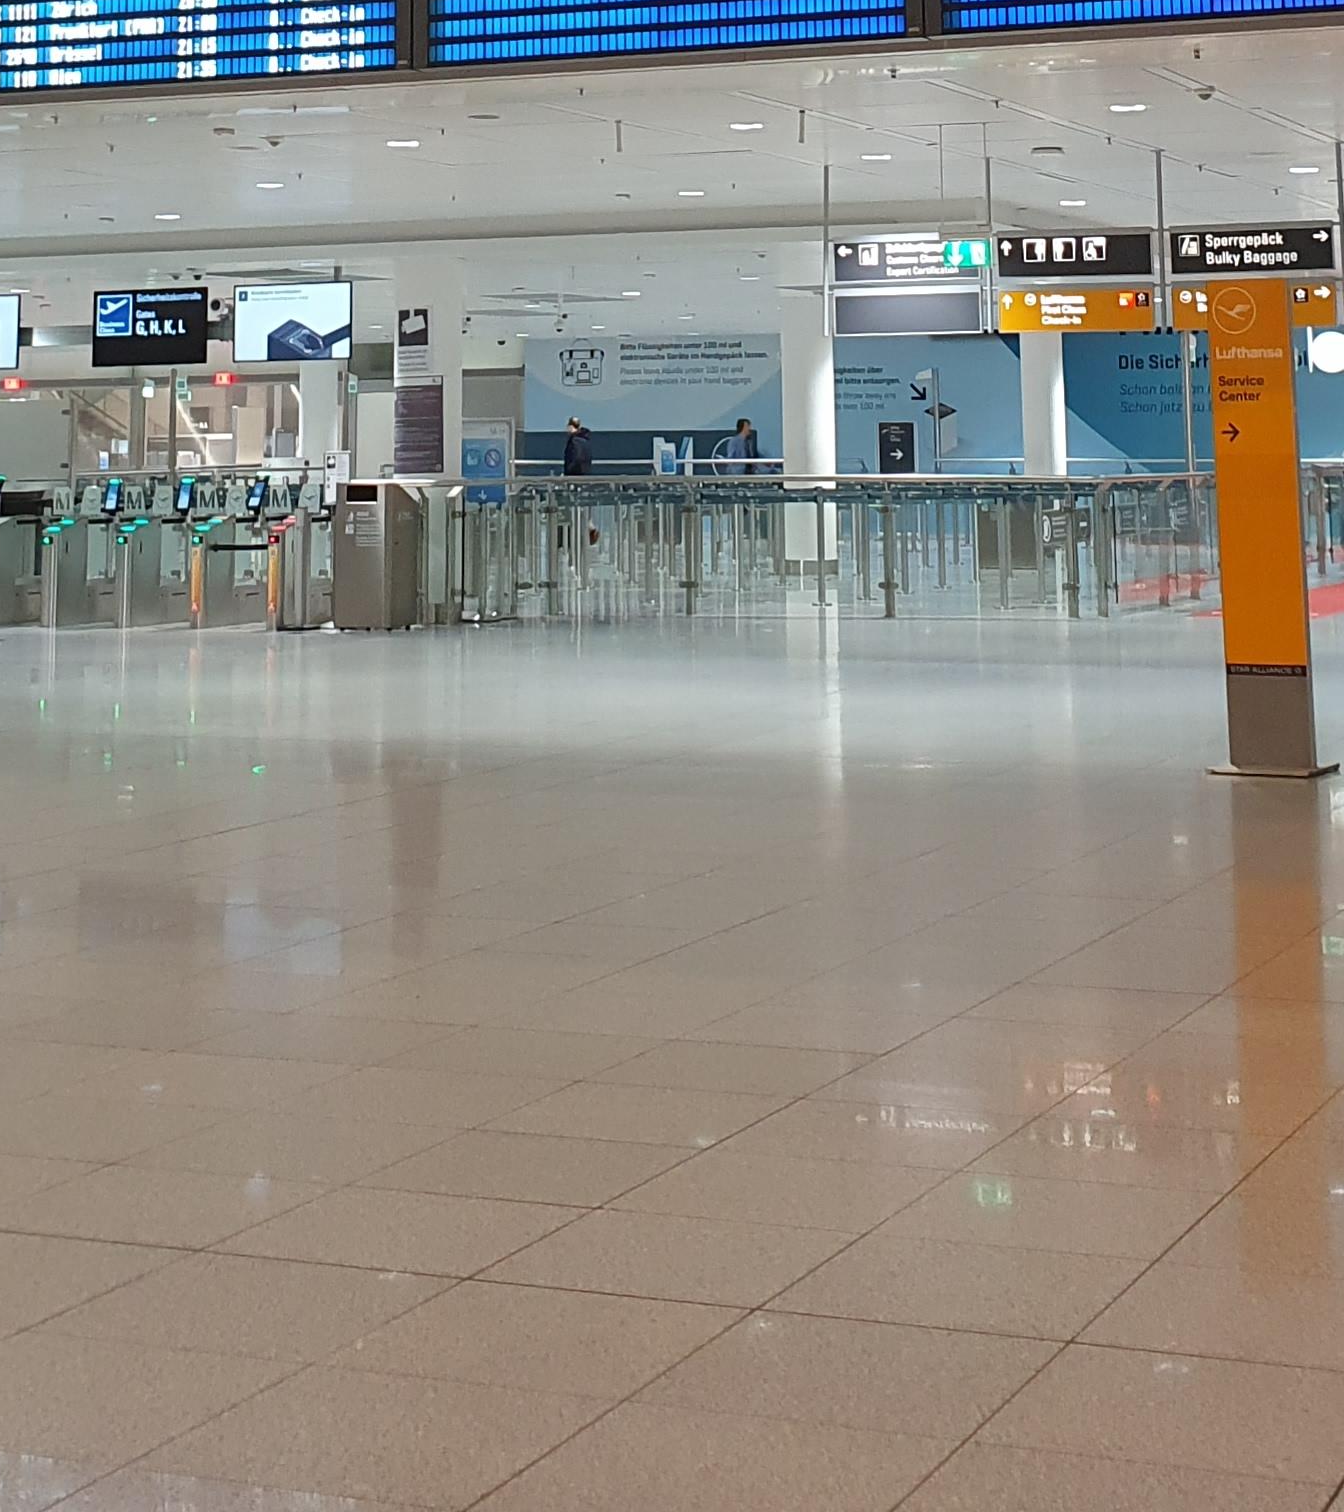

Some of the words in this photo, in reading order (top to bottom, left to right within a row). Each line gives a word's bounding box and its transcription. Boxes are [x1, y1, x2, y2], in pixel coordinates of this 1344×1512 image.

[1205, 232, 1283, 249] Sperrgepäck
[1206, 252, 1240, 266] Bulky
[1244, 250, 1298, 265] Baggage
[136, 320, 147, 336] G,
[150, 320, 162, 336] H,
[164, 320, 176, 335] K,
[179, 320, 185, 333] L
[1216, 346, 1283, 361] Lufthansa
[1118, 355, 1136, 370] Die
[1149, 354, 1208, 369] Sichrh
[1218, 376, 1264, 387] Service
[1219, 391, 1261, 402] Center
[127, 493, 142, 510] M
[199, 491, 216, 508] M
[272, 491, 288, 507] M
